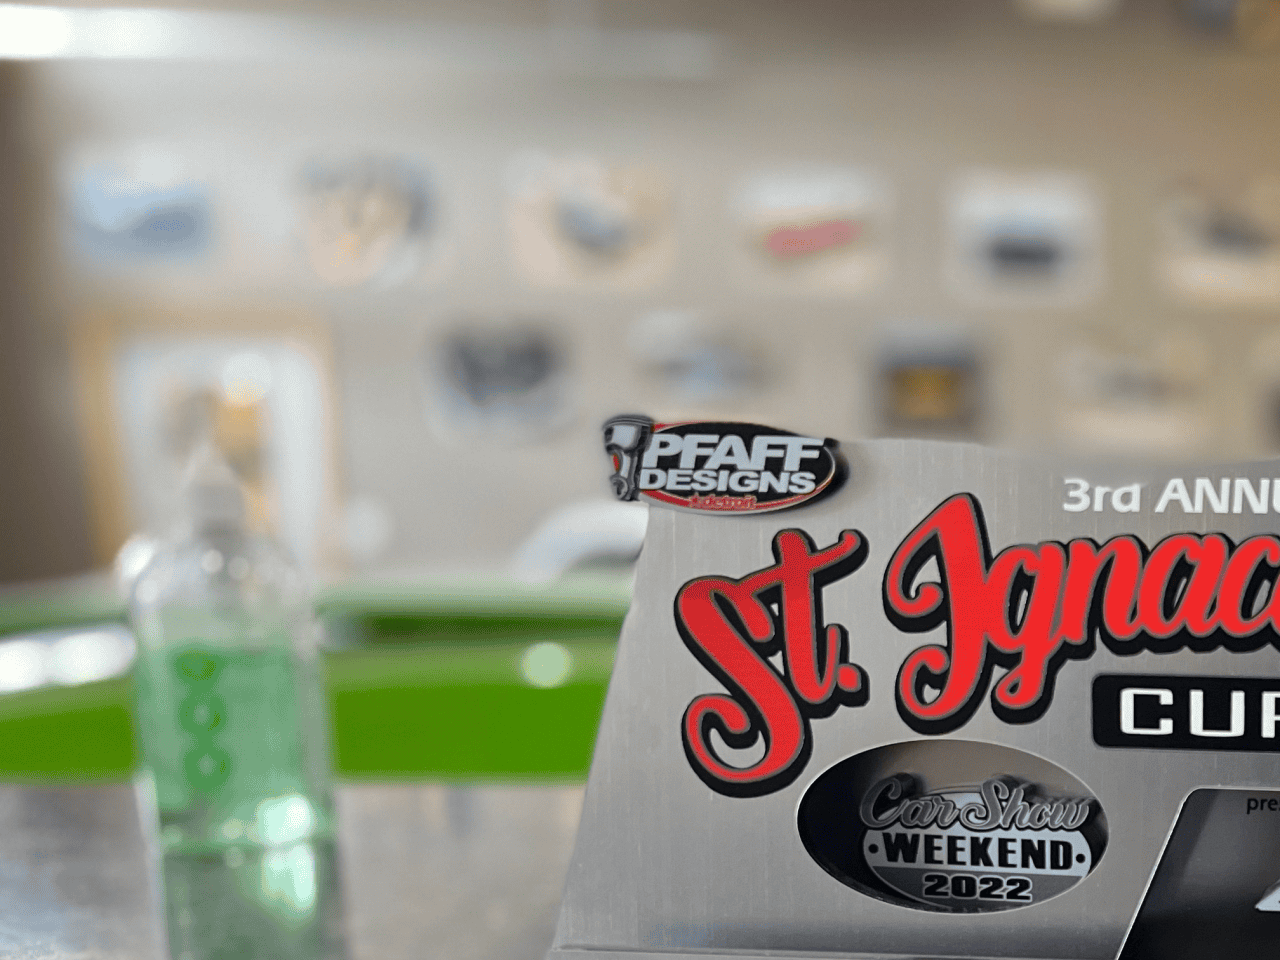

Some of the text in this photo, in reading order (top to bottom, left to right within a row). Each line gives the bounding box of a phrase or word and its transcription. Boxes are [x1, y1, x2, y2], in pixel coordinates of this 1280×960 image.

[642, 433, 825, 472] PFAFF
[639, 468, 816, 493] DESIGNS
[1063, 478, 1141, 513] 3rd
[675, 529, 868, 797] St.
[860, 775, 1091, 832] Car Show
[881, 831, 1074, 871] WEEKEND
[922, 873, 1033, 902] 2022
